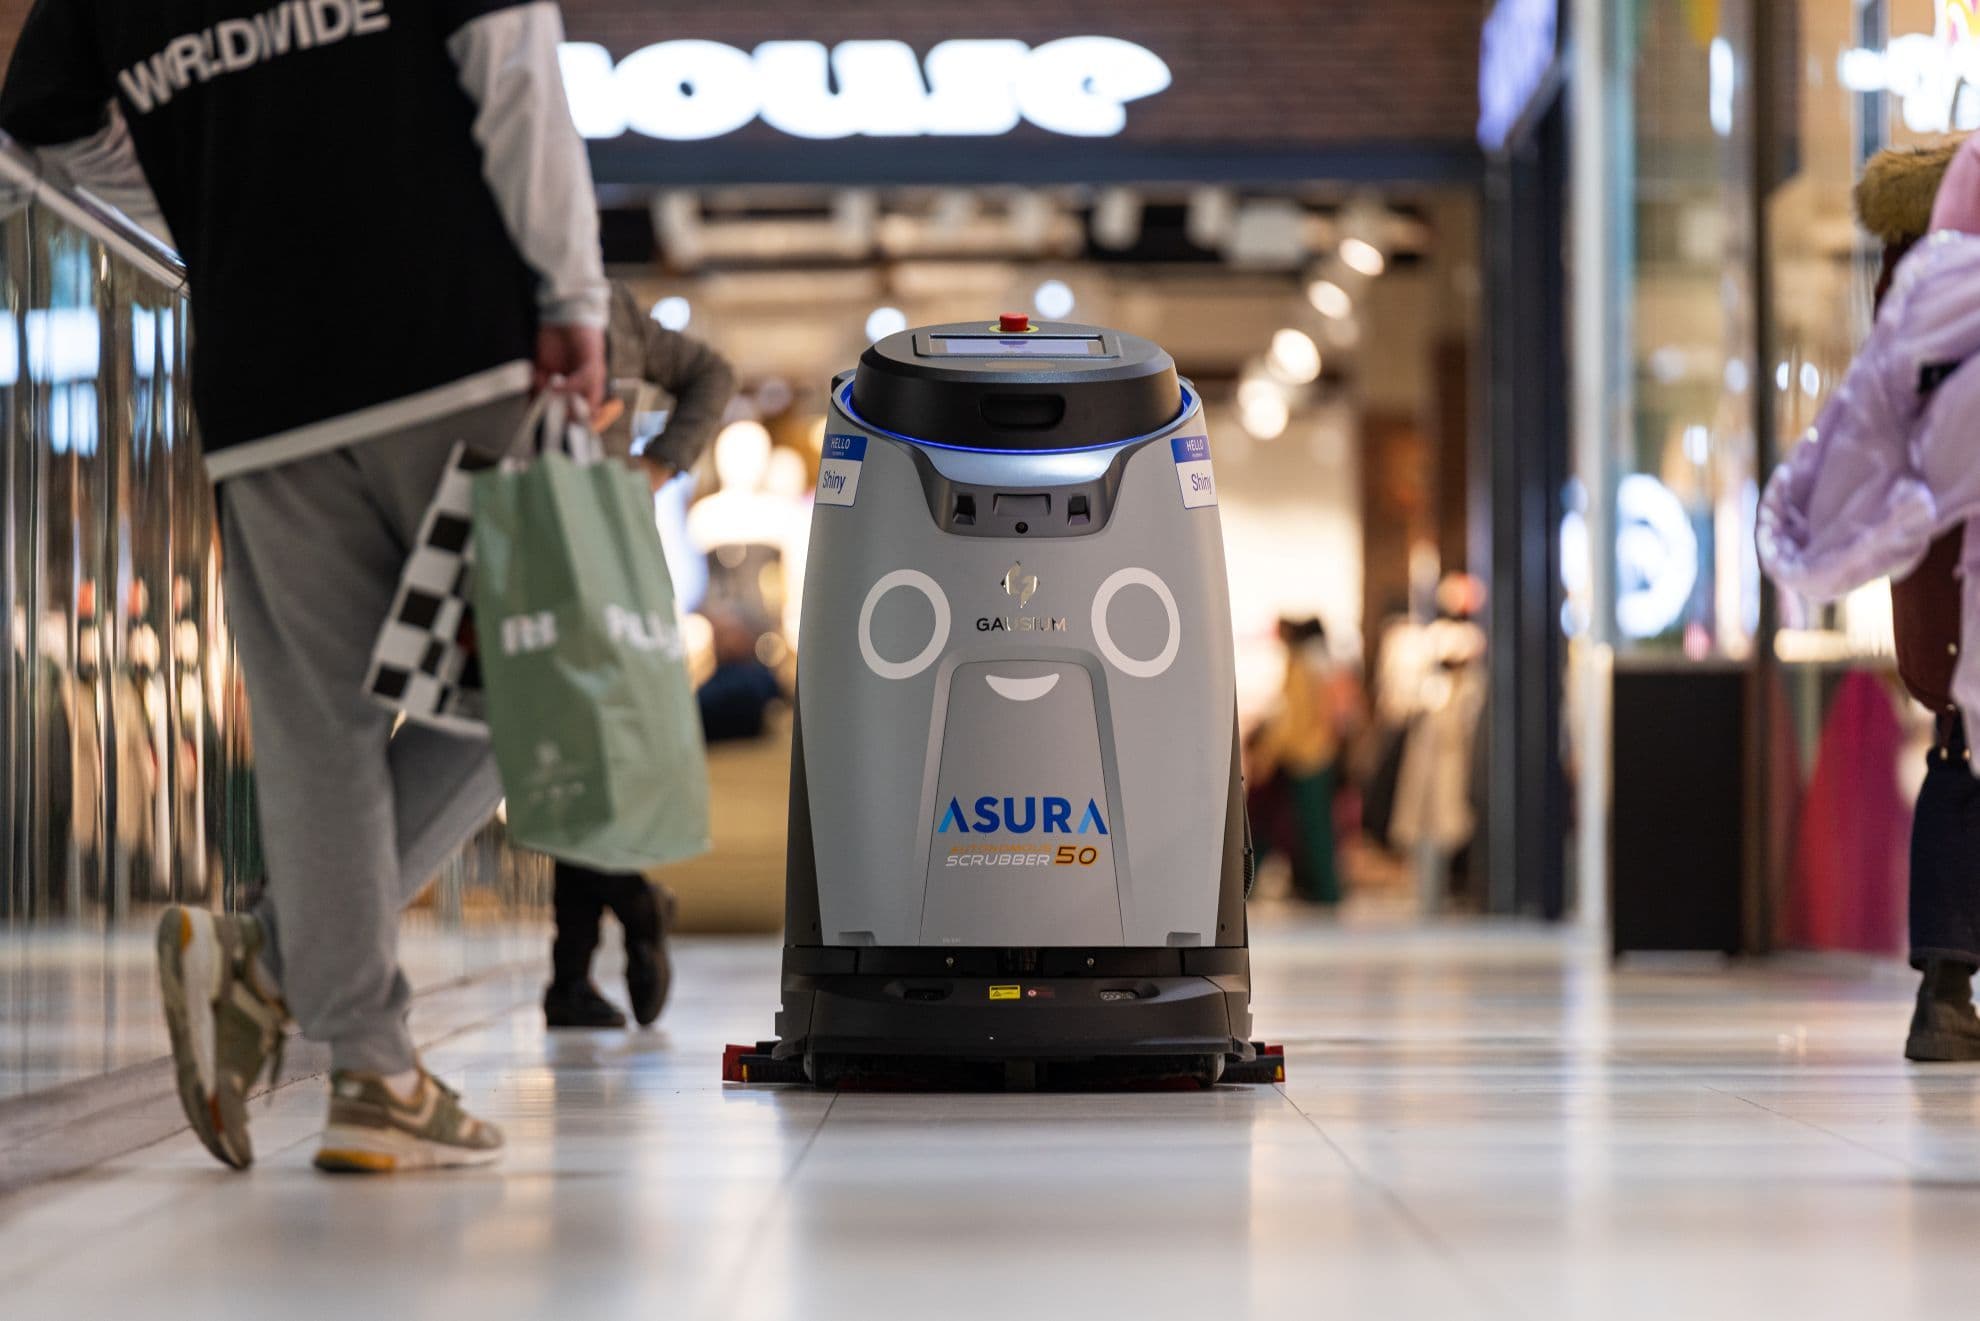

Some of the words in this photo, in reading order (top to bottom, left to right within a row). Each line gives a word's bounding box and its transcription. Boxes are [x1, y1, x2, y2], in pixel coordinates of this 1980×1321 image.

[830, 437, 851, 450] HELLO
[1186, 439, 1204, 452] HELLO
[823, 470, 846, 495] Shiny
[1191, 473, 1212, 495] Shiny
[976, 617, 1066, 631] GAUSIUM
[937, 796, 1109, 835] ASURA
[945, 853, 1051, 867] SCRUBBER
[1055, 845, 1099, 866] 50
